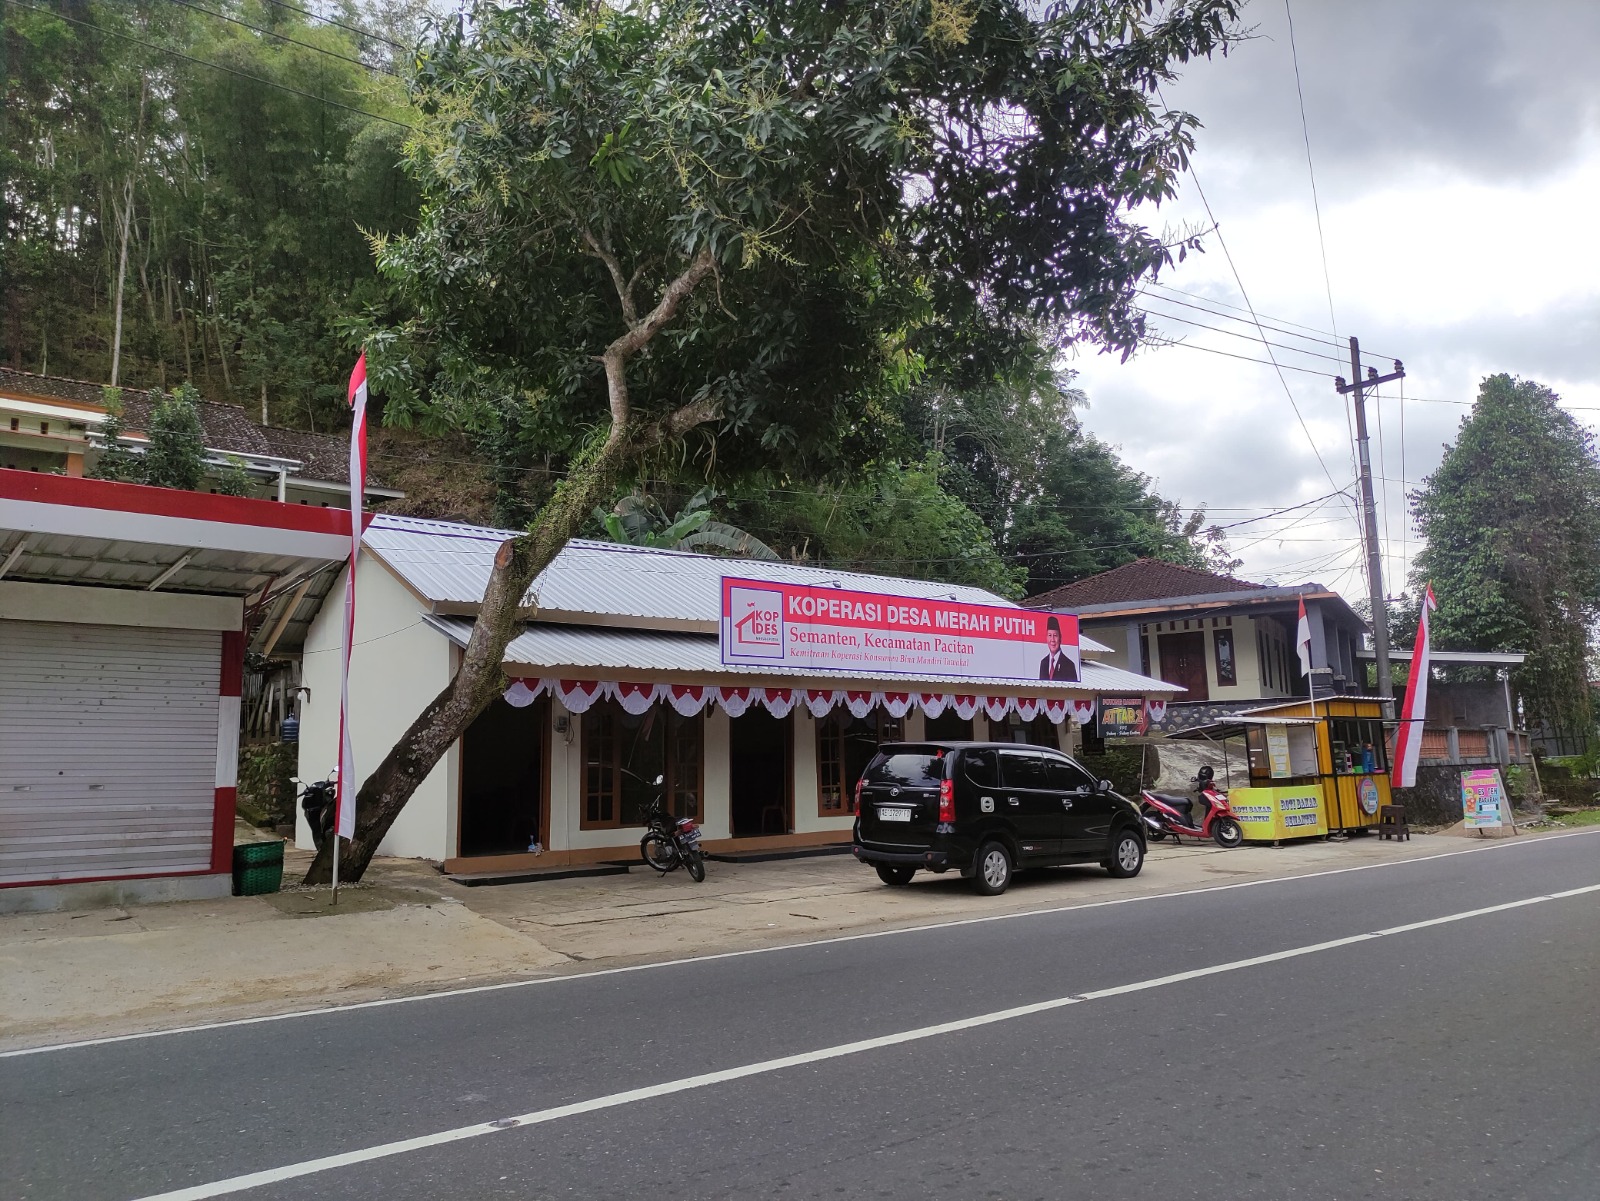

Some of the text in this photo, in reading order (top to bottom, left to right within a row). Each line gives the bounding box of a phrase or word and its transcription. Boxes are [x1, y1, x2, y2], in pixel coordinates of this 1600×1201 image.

[755, 610, 779, 621] KOP
[788, 595, 1036, 636] KOPERASI DESA MERAH PUTIH
[755, 622, 778, 635] DES
[789, 626, 975, 655] Semanten, Kecamatan Pacitan
[789, 647, 830, 659] Kemitraan
[831, 649, 863, 661] Koperasi
